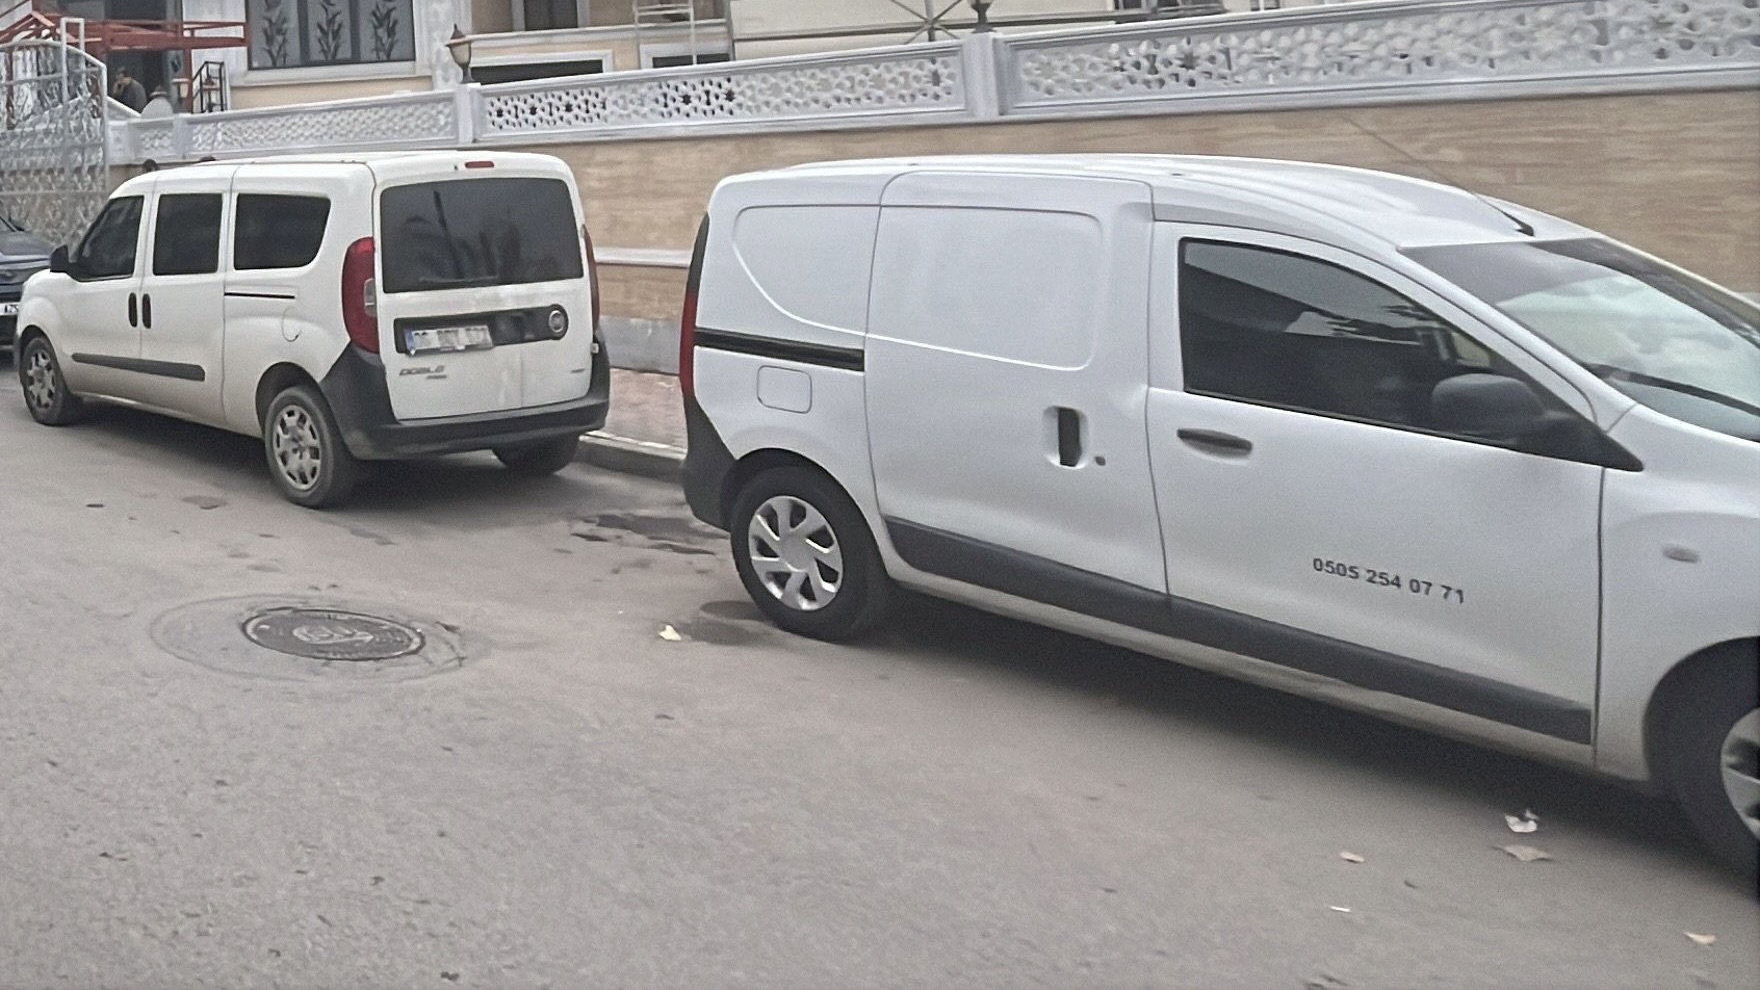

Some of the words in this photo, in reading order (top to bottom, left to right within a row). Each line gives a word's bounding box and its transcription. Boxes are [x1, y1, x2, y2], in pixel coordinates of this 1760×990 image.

[1312, 557, 1360, 580] 0505
[1365, 568, 1402, 589] 254
[1408, 578, 1433, 596] 07
[1440, 584, 1465, 605] 71
